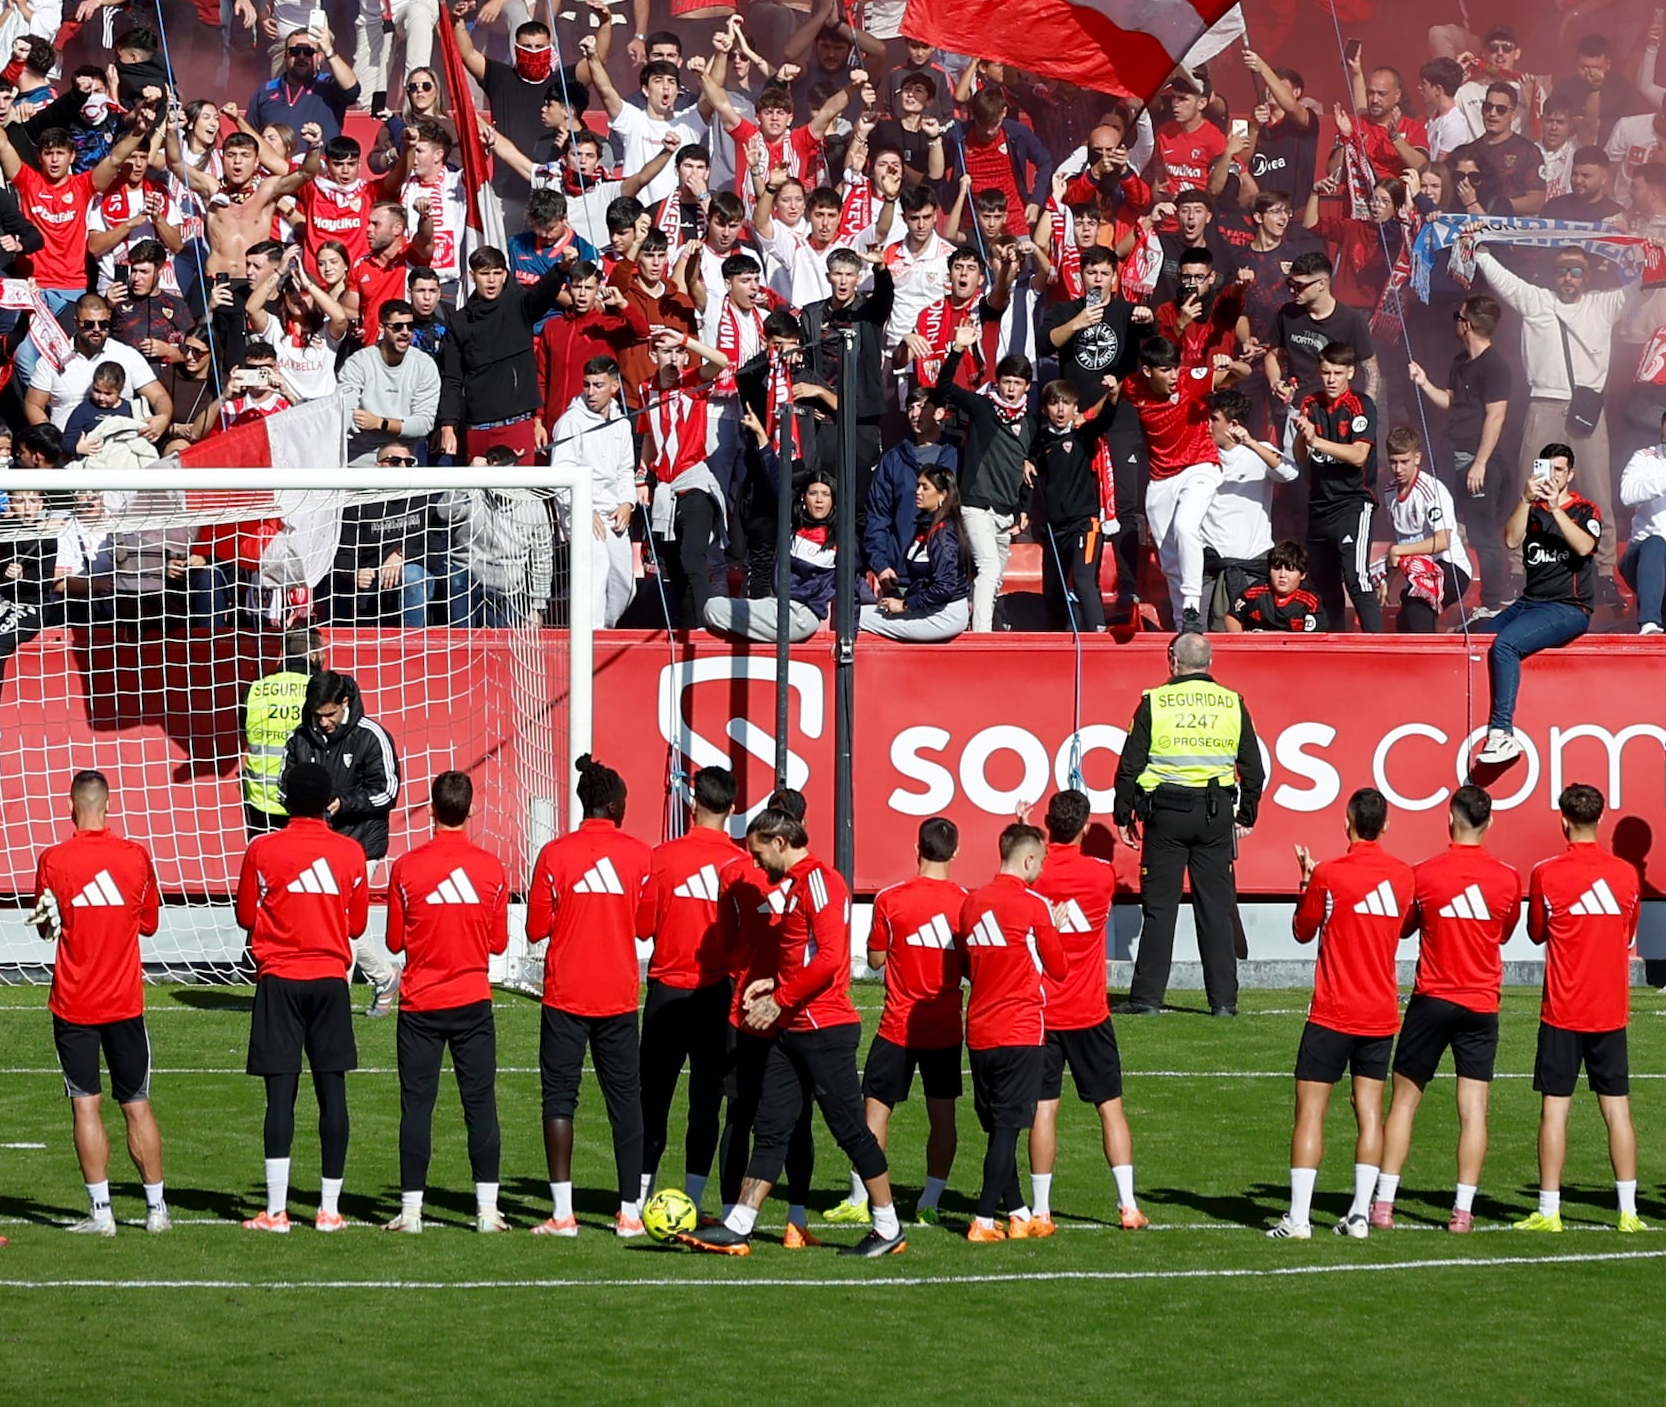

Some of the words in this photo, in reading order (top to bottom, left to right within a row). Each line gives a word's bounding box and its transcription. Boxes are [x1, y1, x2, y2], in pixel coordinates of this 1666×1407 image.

[39, 209, 76, 225] betfair
[926, 298, 946, 346] NUNC
[1527, 542, 1571, 566] Midea
[1157, 692, 1234, 710] SEGURIDAD
[268, 704, 301, 721] 203
[1174, 712, 1219, 730] 2247
[1172, 736, 1235, 750] PROSEGUR
